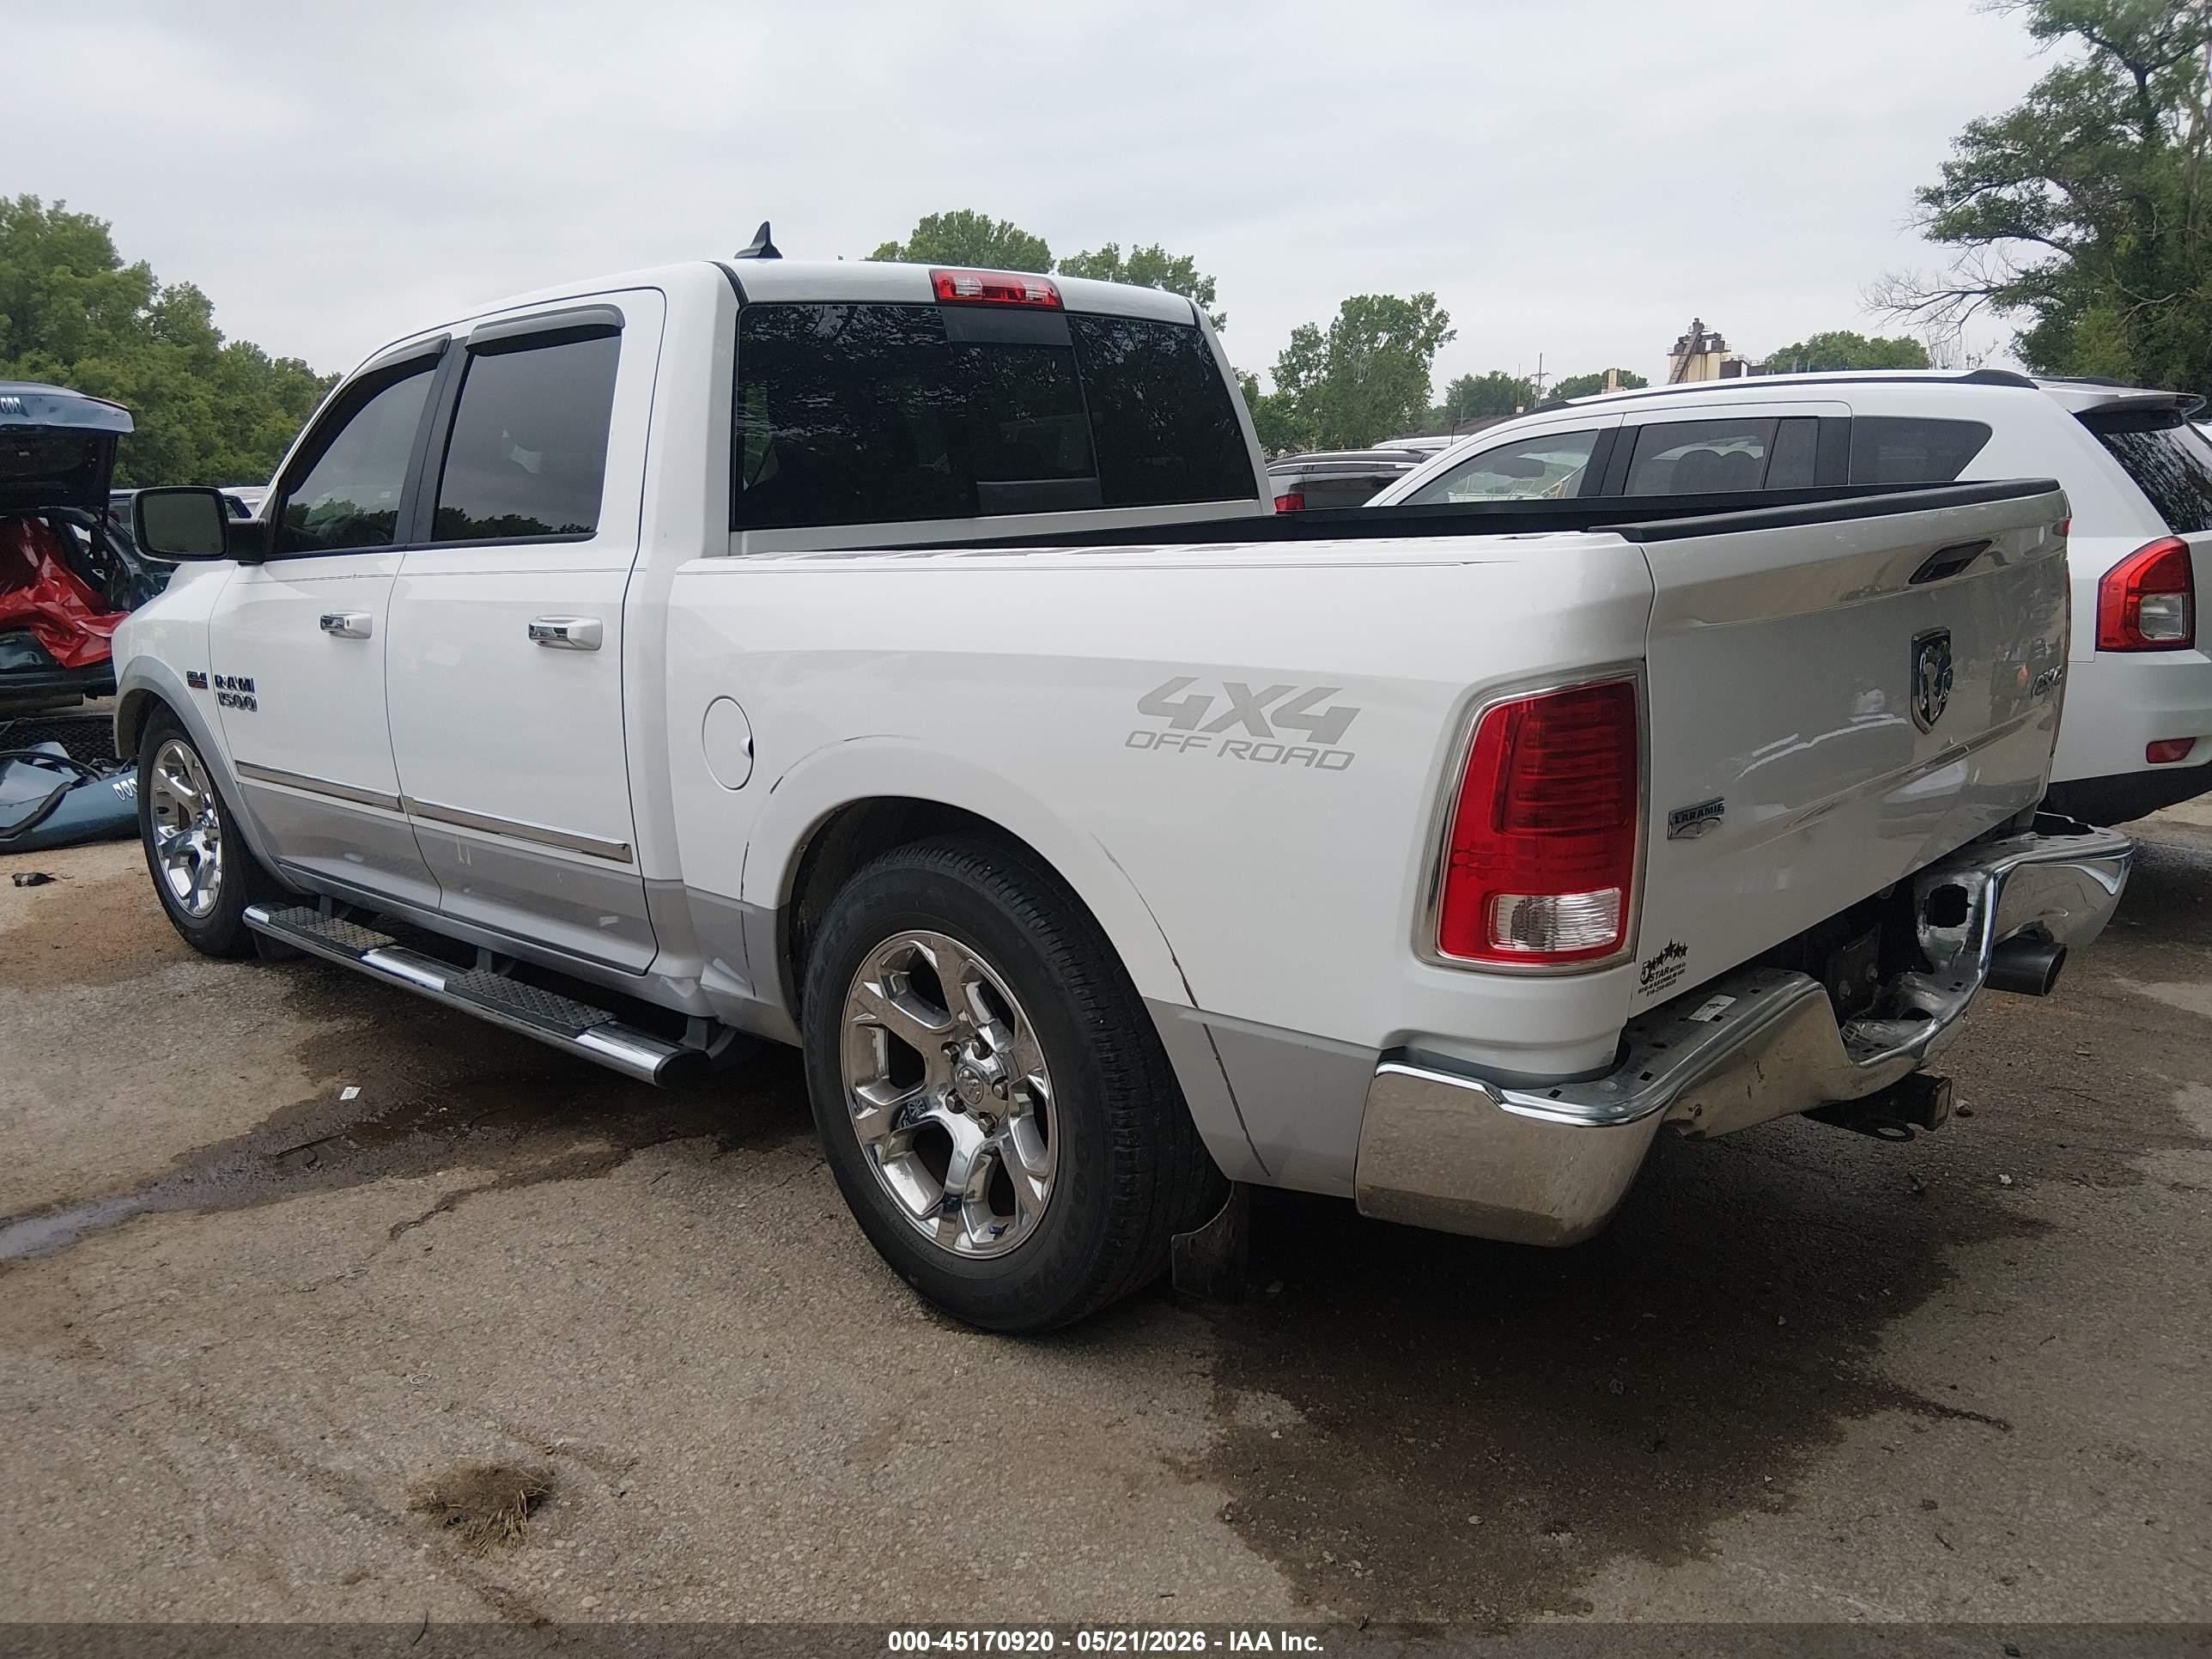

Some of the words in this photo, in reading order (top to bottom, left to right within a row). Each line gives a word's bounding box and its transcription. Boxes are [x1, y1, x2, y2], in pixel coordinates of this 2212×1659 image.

[214, 675, 256, 693] RAM
[217, 692, 258, 712] 1500
[1137, 676, 1362, 745] 4X4
[1125, 730, 1212, 753] OFF
[1217, 739, 1355, 771] ROAD
[1674, 802, 1725, 824] LARAMIE
[1649, 966, 1670, 981] STAR
